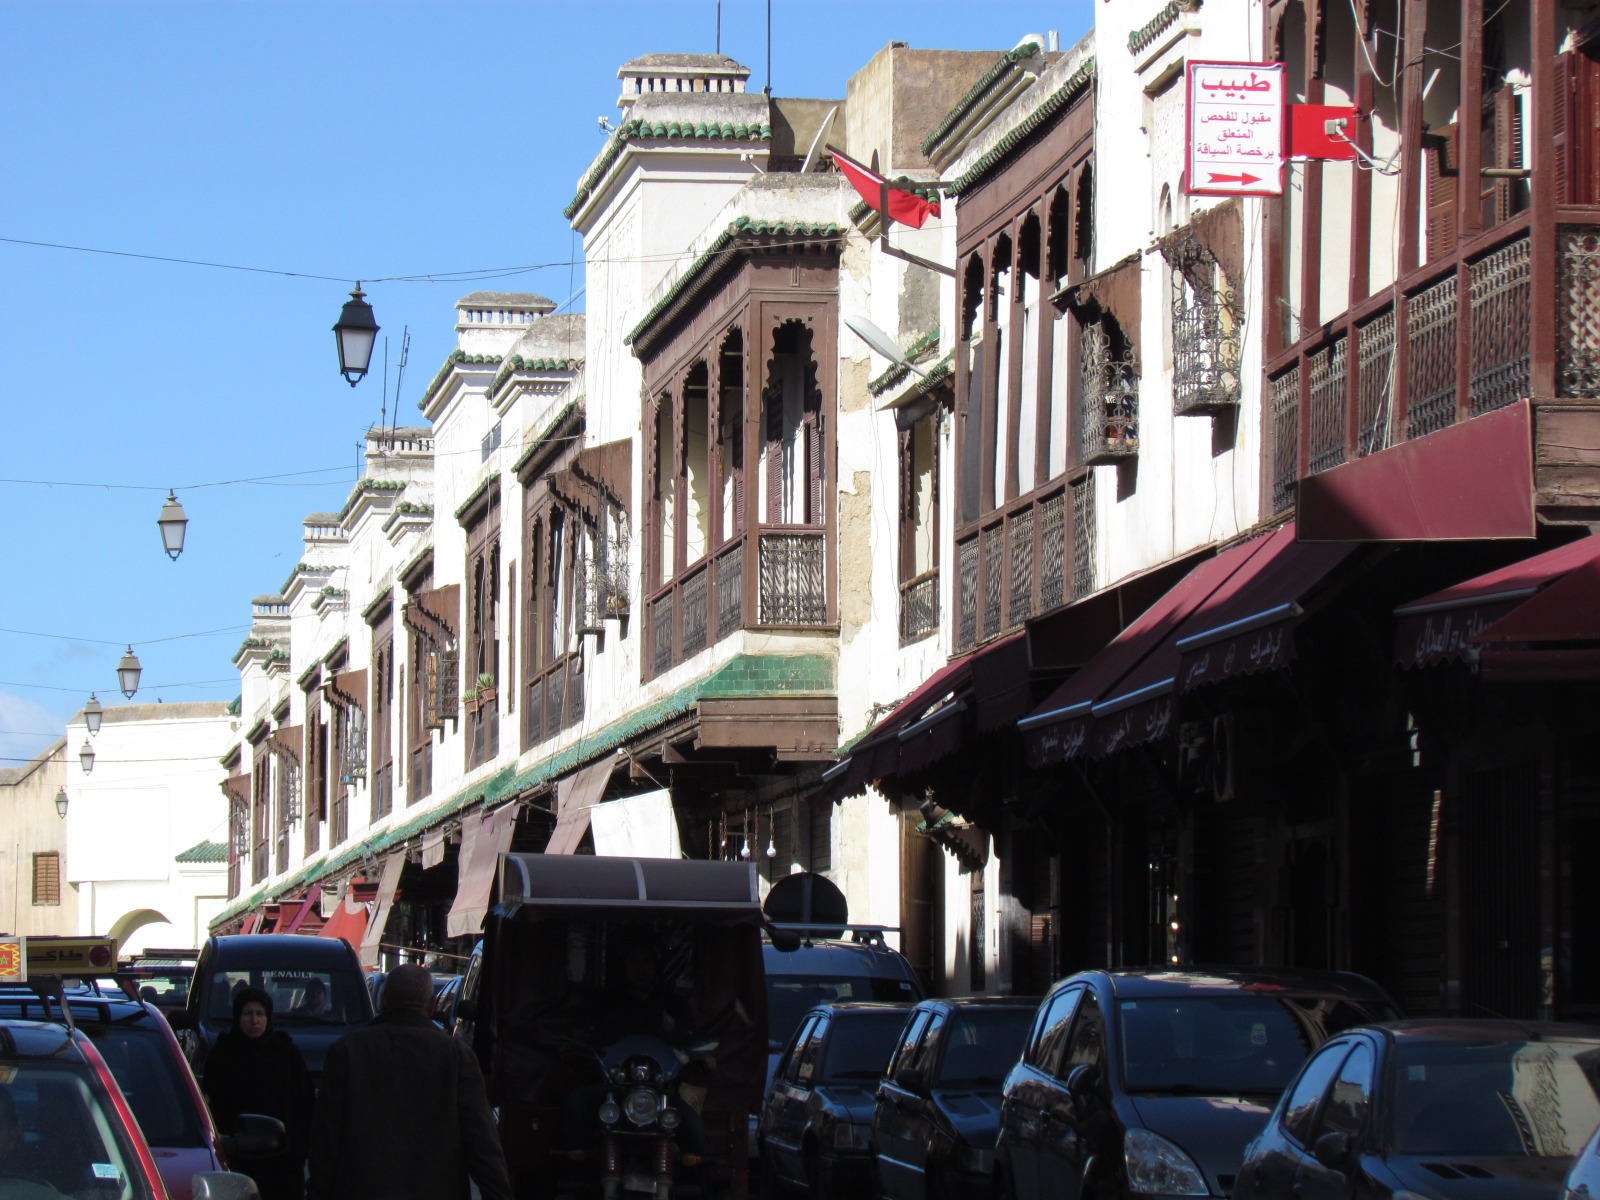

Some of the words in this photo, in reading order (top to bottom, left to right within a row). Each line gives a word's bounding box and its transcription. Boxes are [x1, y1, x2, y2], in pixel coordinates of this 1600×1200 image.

[1201, 72, 1271, 100] طبيب
[1200, 111, 1238, 124] للفحص
[1241, 112, 1272, 125] مقبول
[1217, 129, 1254, 142] المتعلق
[1196, 143, 1232, 157] السياقة
[1236, 144, 1275, 159] برخصة
[261, 970, 314, 979] RENAULT
